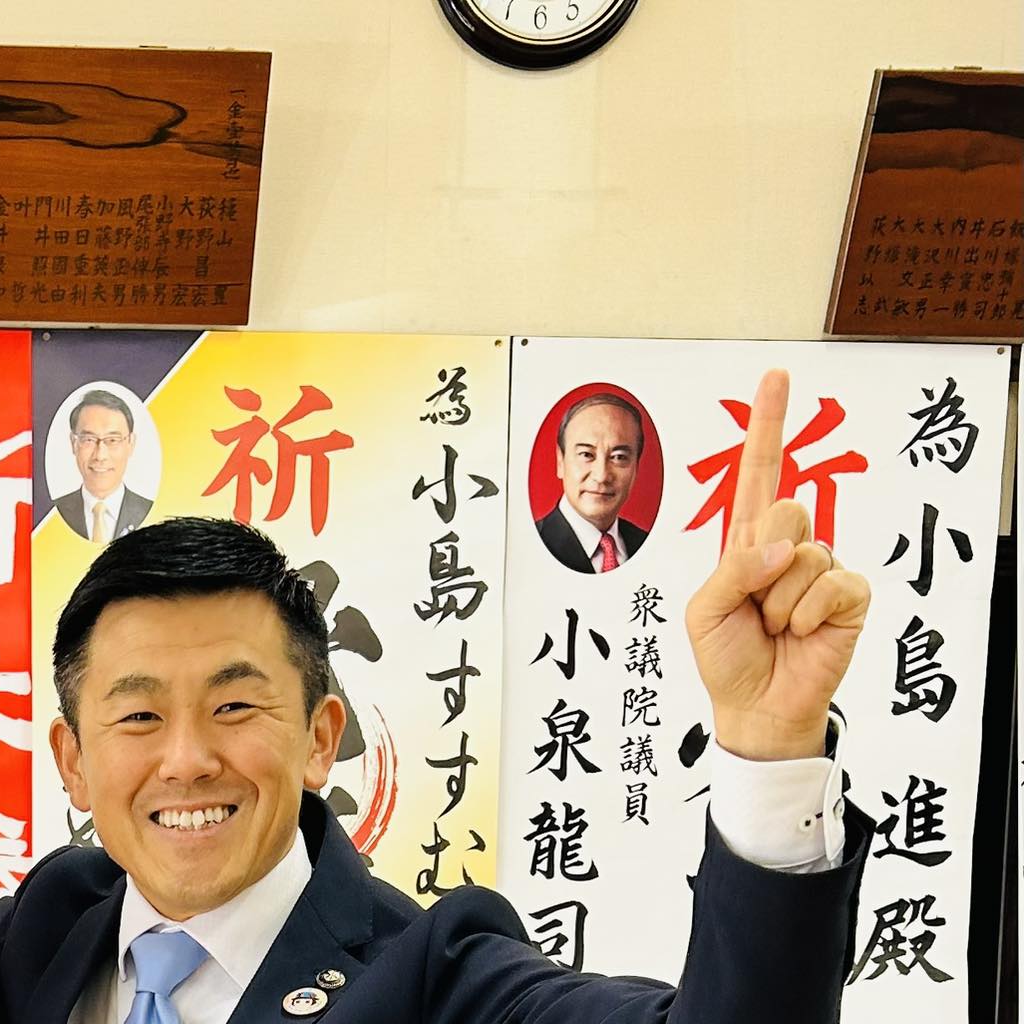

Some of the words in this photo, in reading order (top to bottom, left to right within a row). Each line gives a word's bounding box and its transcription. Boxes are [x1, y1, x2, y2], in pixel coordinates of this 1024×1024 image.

[534, 5, 547, 30] 6
[566, 0, 579, 21] 5
[201, 384, 355, 537] 祈
[412, 366, 500, 898] 為小島すすむ
[619, 582, 668, 827] 衆議院議員
[846, 376, 980, 986] 為小島進殿
[522, 608, 611, 974] 小泉龍司
